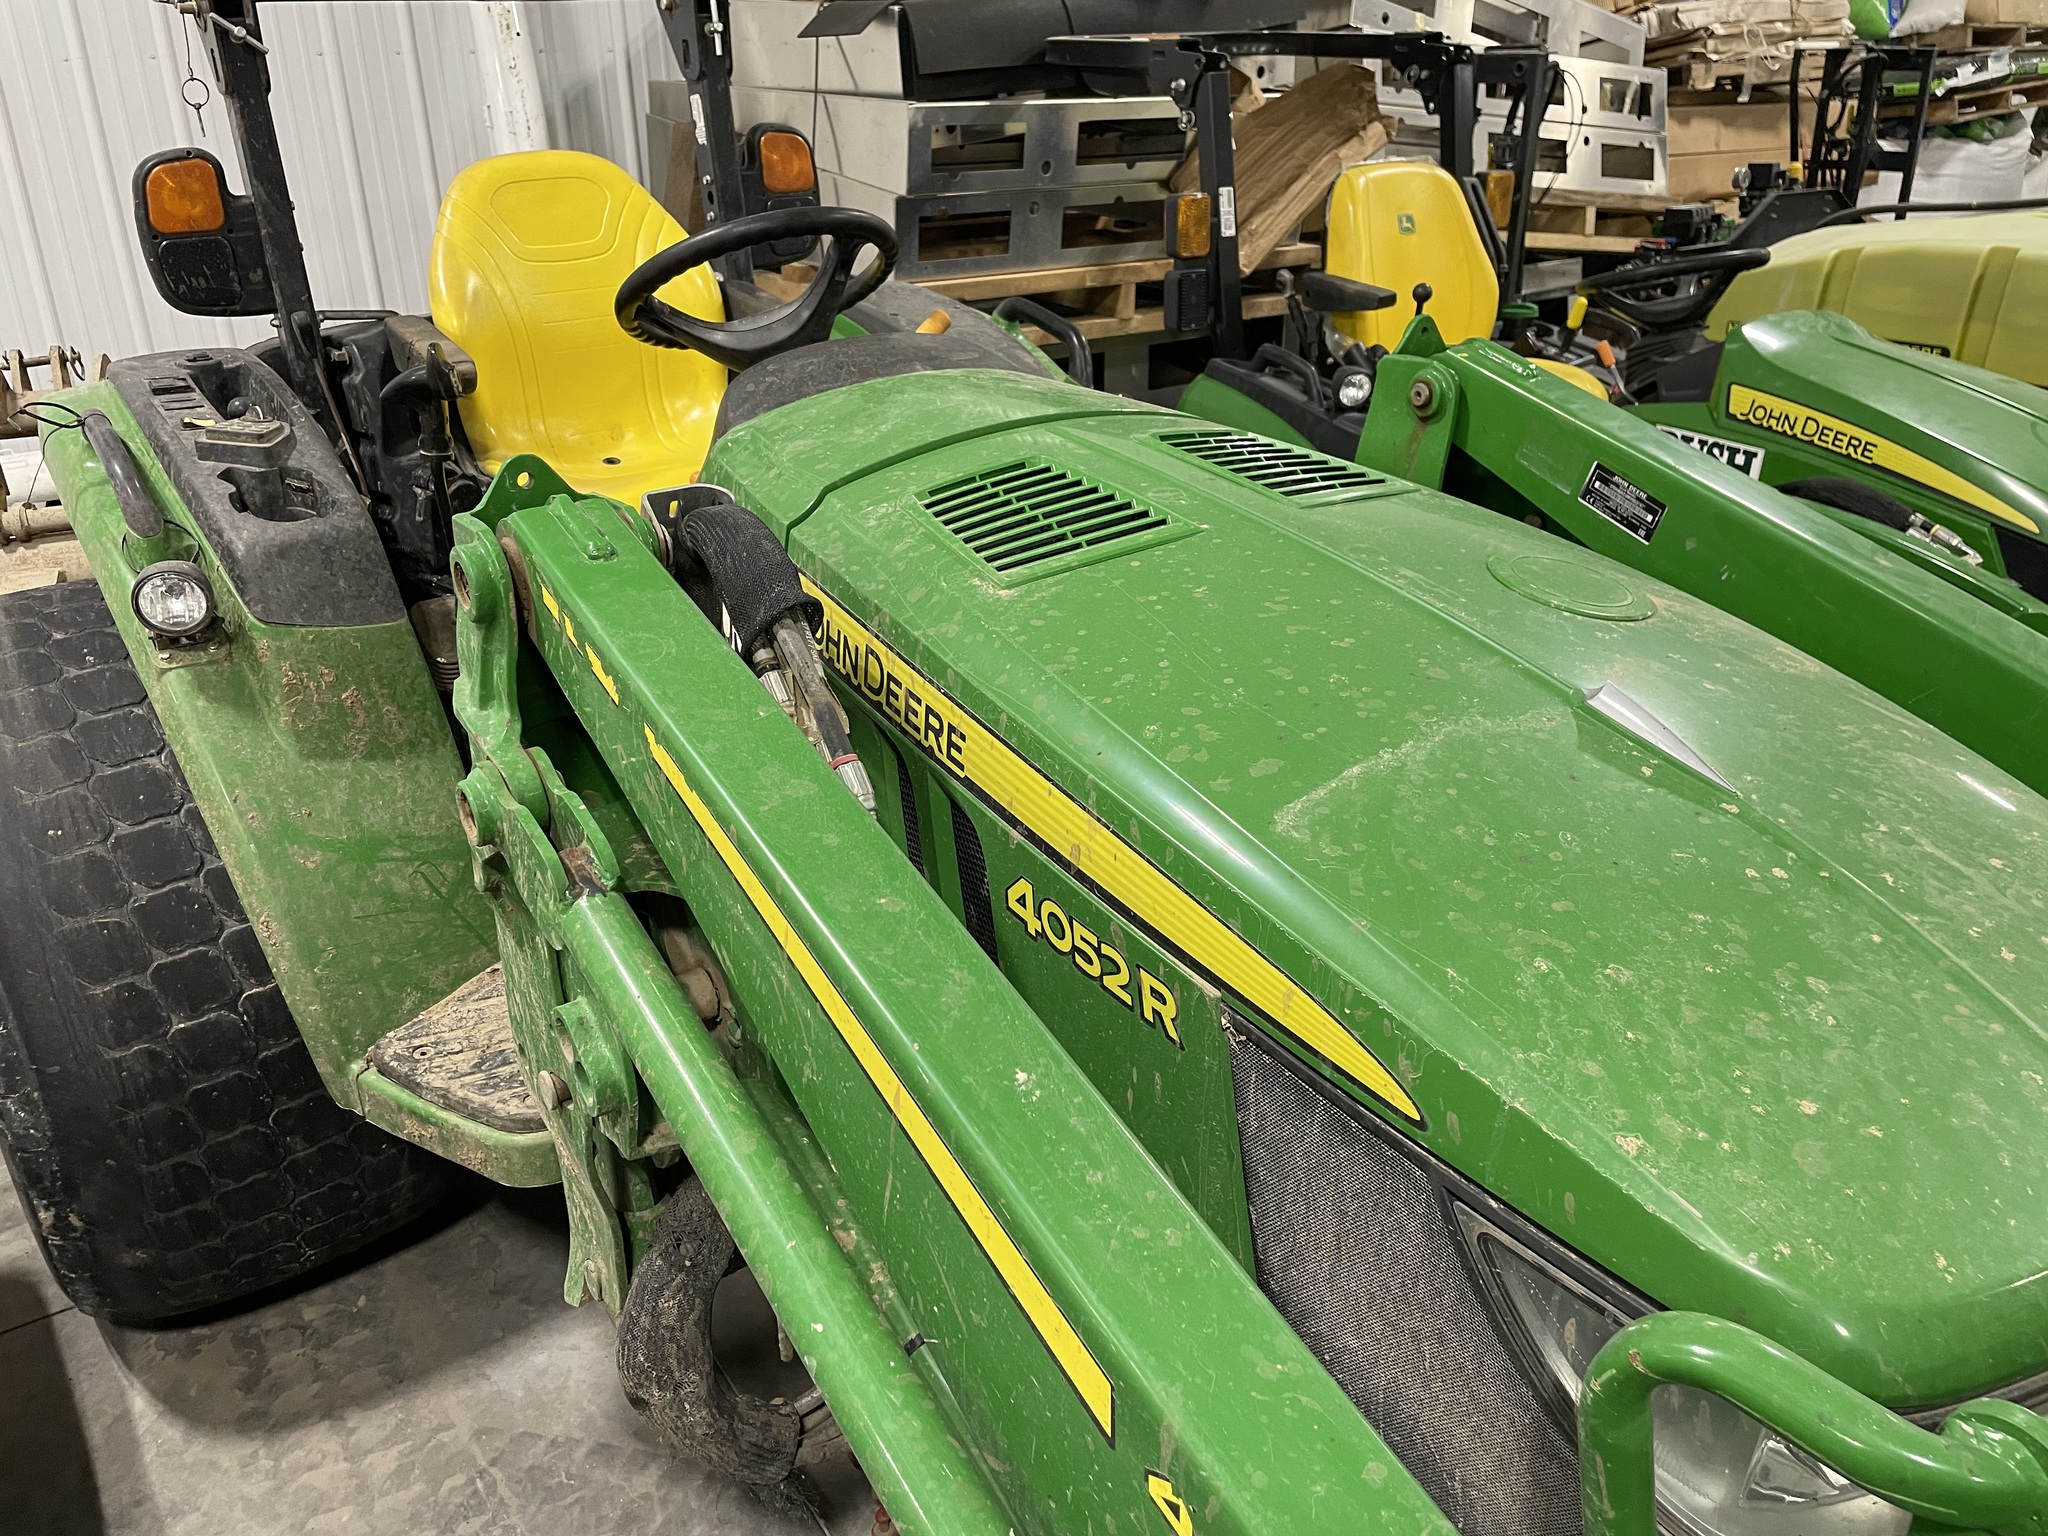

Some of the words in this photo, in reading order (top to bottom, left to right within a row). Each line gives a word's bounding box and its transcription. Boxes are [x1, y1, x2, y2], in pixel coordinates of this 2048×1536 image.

[1661, 430, 1758, 476] SH
[1740, 399, 1798, 432] JOHN
[1800, 416, 1878, 461] DEERE
[815, 619, 859, 685] HN
[863, 643, 967, 774] DEERE
